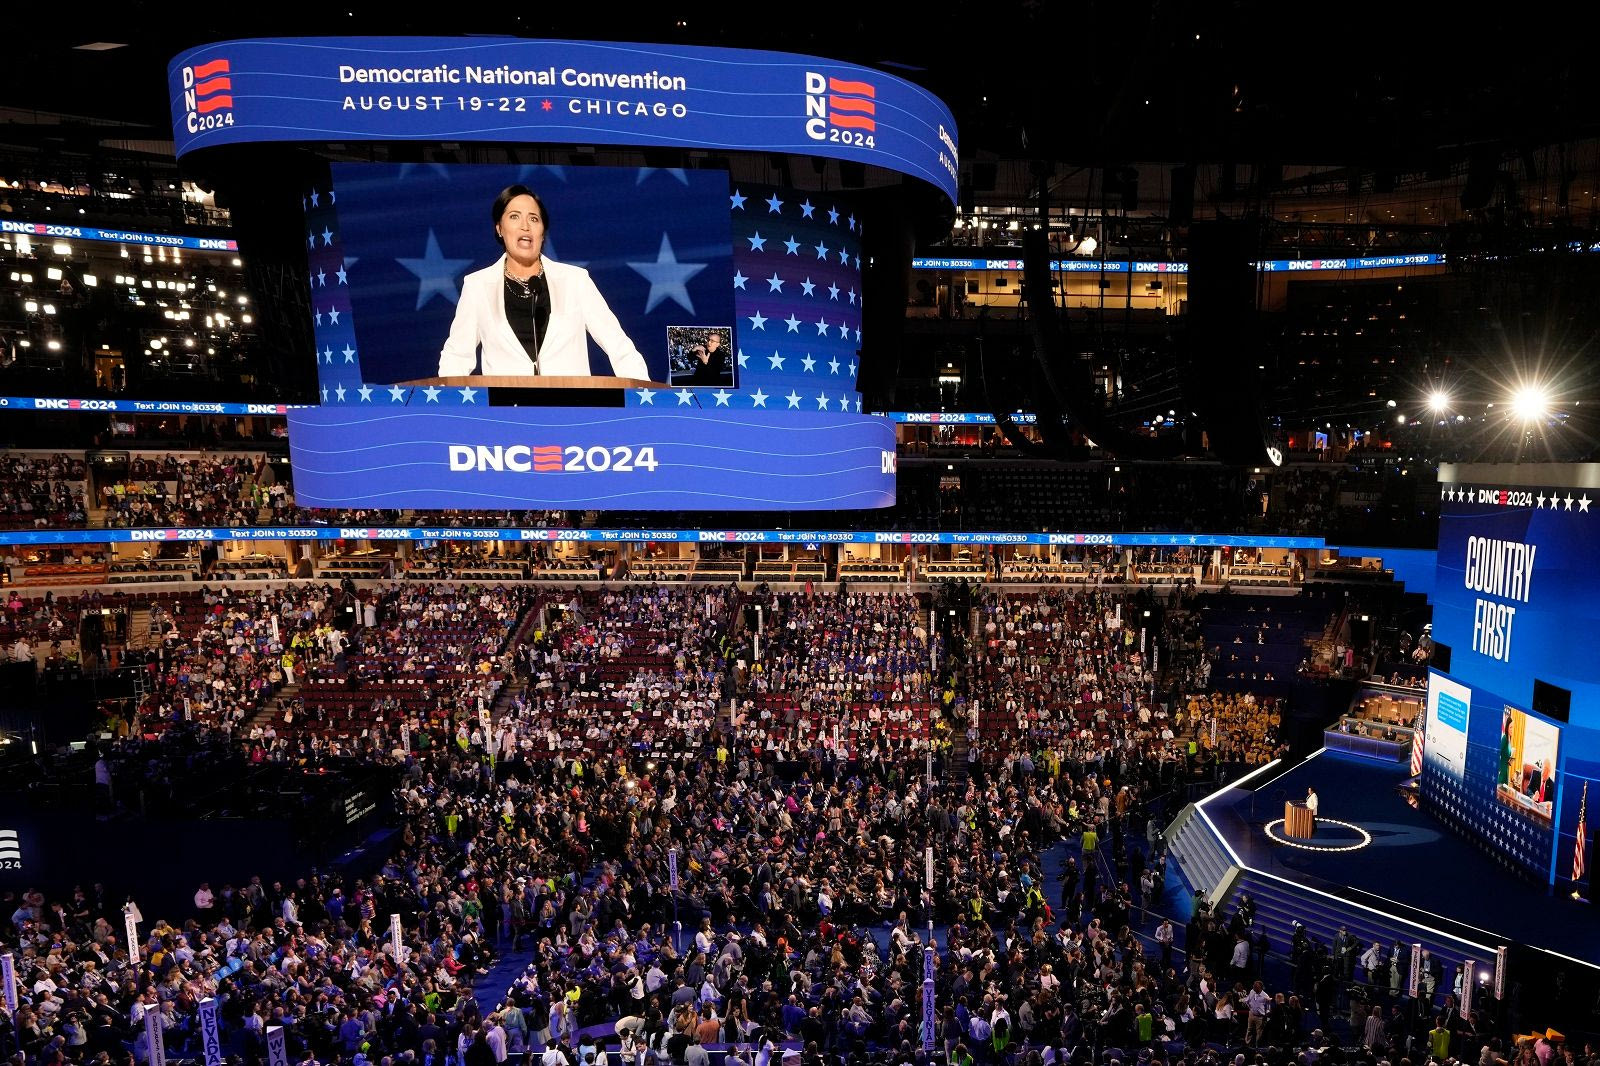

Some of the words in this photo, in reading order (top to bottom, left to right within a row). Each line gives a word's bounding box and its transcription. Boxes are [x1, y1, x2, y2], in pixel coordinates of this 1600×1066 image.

[339, 64, 460, 84] Democratic
[466, 66, 556, 85] National
[561, 68, 686, 91] Convention
[342, 96, 443, 111] AUGUST
[458, 96, 526, 112] 19-22
[568, 99, 687, 118] CHICAGO
[199, 113, 234, 131] 2024
[829, 129, 875, 149] 2024
[47, 225, 81, 237] 2024
[98, 231, 118, 240] Text
[119, 233, 142, 242] JOIN
[144, 235, 153, 243] to
[155, 236, 184, 245] 30330
[1376, 257, 1395, 265] JOIN
[1396, 257, 1403, 265] to
[81, 401, 117, 410] 2024
[134, 402, 155, 410] Text
[157, 402, 180, 411] JOIN
[181, 403, 191, 411] to
[940, 413, 965, 422] 2024
[449, 445, 531, 472] DNC
[564, 446, 658, 472] 2024
[1507, 491, 1532, 506] 2024
[178, 530, 213, 540] 2024
[230, 530, 250, 538] Text
[252, 529, 275, 537] JOIN
[276, 529, 286, 537] to
[288, 529, 317, 537] 30330
[378, 529, 407, 538] 2024
[422, 530, 439, 538] Text
[441, 530, 461, 538] JOIN
[463, 530, 471, 538] to
[473, 530, 499, 538] 30330
[558, 530, 587, 540] 2024
[601, 531, 618, 540] Text
[619, 531, 640, 539] JOIN
[641, 531, 650, 539] to
[651, 531, 677, 539] 30330
[735, 532, 765, 541] 2024
[778, 533, 795, 541] Text
[796, 533, 816, 541] JOIN
[817, 533, 826, 541] to
[827, 533, 853, 541] 30330
[911, 533, 940, 542] 2024
[953, 534, 970, 542] Text
[971, 534, 991, 542] JOIN
[1084, 534, 1113, 544] 2024
[1465, 535, 1536, 603] COUNTRY
[1472, 598, 1516, 663] FIRST
[202, 1007, 220, 1066] NEVADA
